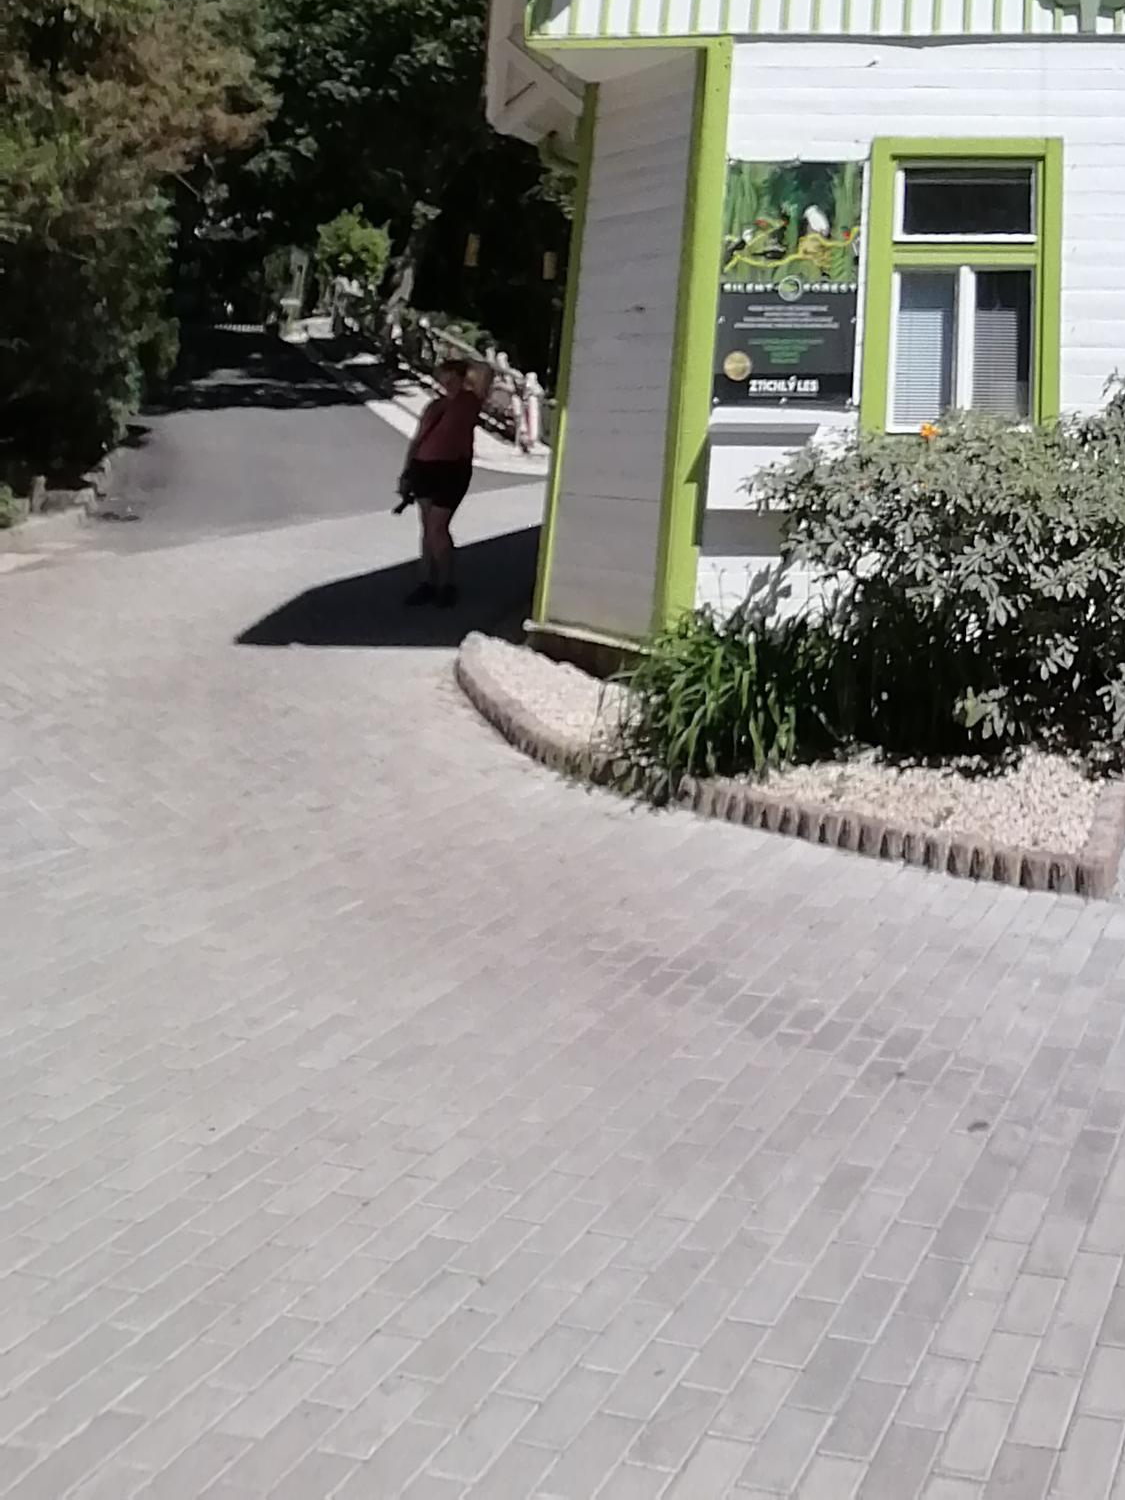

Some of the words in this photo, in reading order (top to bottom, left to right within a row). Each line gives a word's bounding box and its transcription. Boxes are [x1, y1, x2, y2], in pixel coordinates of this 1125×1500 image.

[722, 282, 773, 294] SILENT
[802, 282, 857, 294] FOREST
[797, 379, 819, 392] LES
